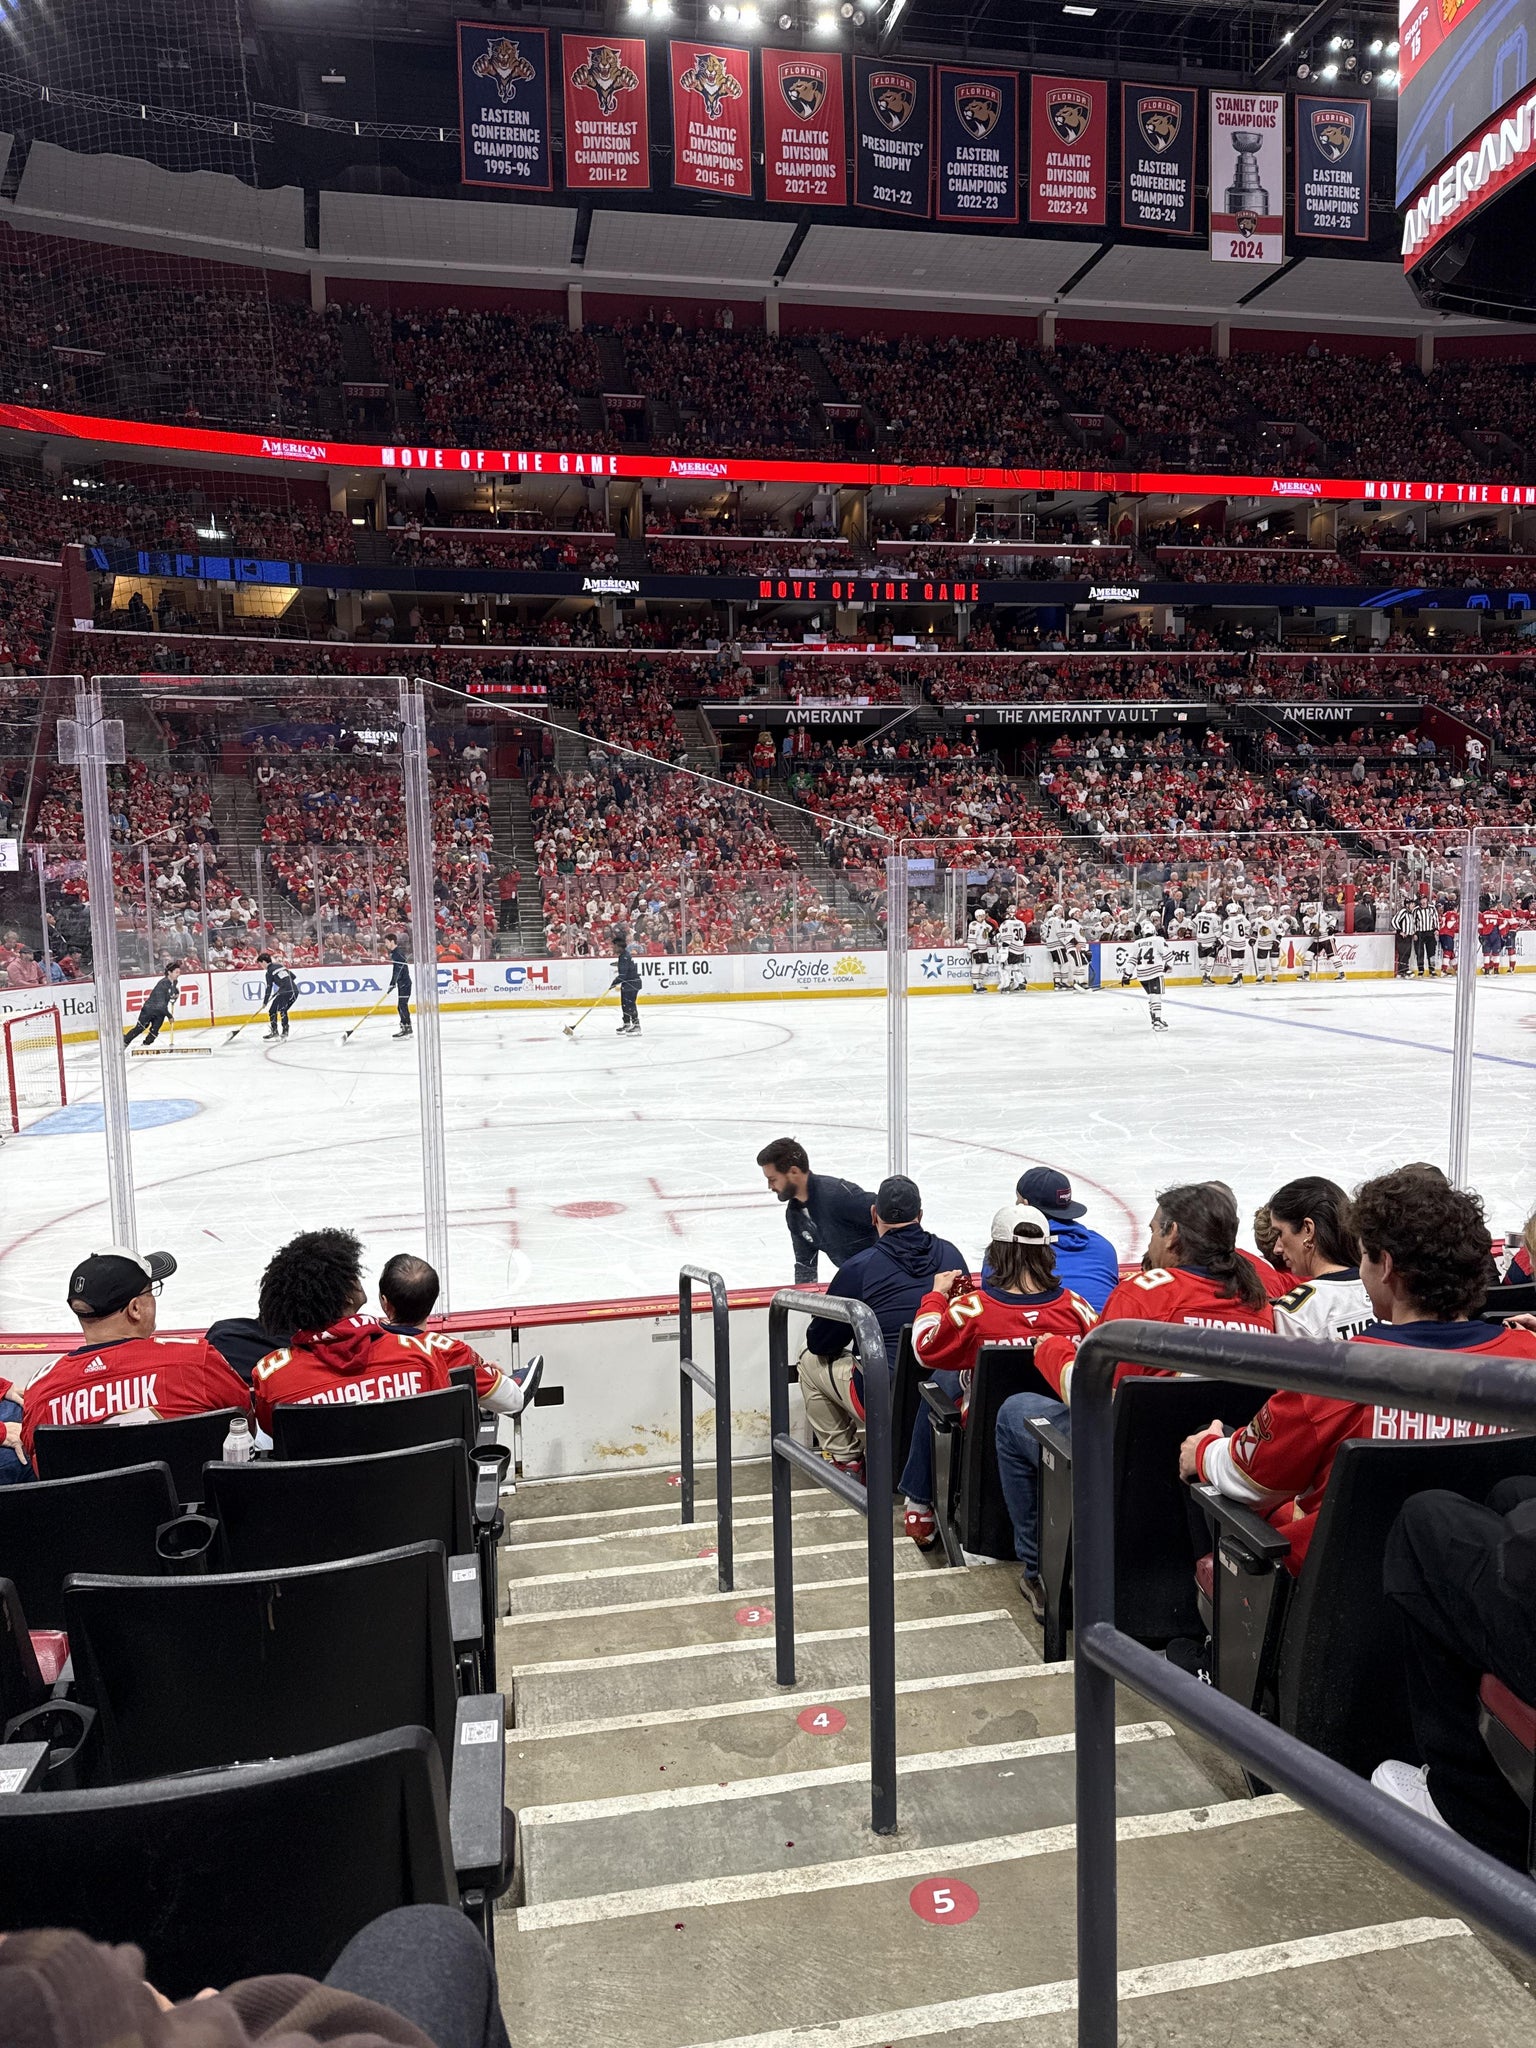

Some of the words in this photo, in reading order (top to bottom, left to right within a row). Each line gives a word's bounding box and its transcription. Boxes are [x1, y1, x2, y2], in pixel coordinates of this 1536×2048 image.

[1404, 6, 1429, 47] SHOTS
[784, 63, 822, 79] FLORIDA
[874, 76, 911, 90] FLORIDA
[960, 86, 996, 98] FLORIDA
[1051, 92, 1087, 105] FLORIDA
[1142, 102, 1177, 114] FLORIDA
[1215, 96, 1257, 113] STANLEY
[1258, 99, 1279, 114] CUP
[480, 107, 531, 126] EASTERN
[1217, 112, 1277, 129] CHAMPIONS
[1315, 113, 1350, 125] FLORIDA
[470, 123, 542, 145] CONFERENCE
[574, 119, 638, 136] SOUTHEAST
[688, 121, 737, 142] ATLANTIC
[582, 135, 632, 151] DIVISION
[780, 128, 829, 145] ATLANTIC
[861, 133, 924, 157] PRESIDENTS'
[473, 140, 540, 161] CHAMPIONS
[690, 137, 736, 157] DIVISION
[782, 145, 829, 161] DIVISION
[955, 146, 1001, 163] EASTERN
[573, 150, 641, 166] CHAMPIONS
[681, 149, 744, 172] CHAMPIONS
[872, 153, 912, 172] TROPHY
[1046, 152, 1092, 168] ATLANTIC
[484, 159, 532, 177] 1995-96
[588, 167, 629, 182] 2011-12
[774, 161, 837, 179] CHAMPIONS
[946, 162, 1009, 179] CONFERENCE
[1046, 168, 1091, 184] DIVISION
[1138, 159, 1179, 177] EASTERN
[1312, 168, 1353, 185] EASTERN
[694, 168, 736, 187] 2015-16
[1130, 173, 1187, 193] CONFERENCE
[784, 179, 828, 195] 2021-22
[872, 184, 913, 205] 2021-22
[947, 178, 1008, 195] CHAMPIONS
[1039, 183, 1098, 200] CHAMPIONS
[1304, 182, 1361, 200] CONFERENCE
[957, 194, 1000, 210] 2022-23
[1047, 199, 1089, 215] 2023-24
[1131, 189, 1185, 208] CHAMPIONS
[1305, 198, 1359, 215] CHAMPIONS
[1138, 205, 1177, 223] 2023-24
[1313, 213, 1352, 229] 2024-25
[1229, 240, 1265, 259] 2024
[347, 387, 363, 397] 332
[606, 398, 623, 408] 333
[1087, 418, 1102, 427] 302
[261, 439, 327, 459] AMERICAN
[381, 447, 443, 468] MOVE
[460, 451, 485, 470] OF
[502, 452, 543, 472] THE
[559, 454, 618, 475] GAME
[668, 459, 728, 475] AMERICAN
[1270, 480, 1322, 495] AMERICAN
[1364, 482, 1412, 499] MOVE
[1425, 485, 1444, 500] OF
[1458, 485, 1488, 502] THE
[581, 577, 641, 593] AMERICAN
[759, 580, 817, 599] MOVE
[832, 581, 856, 600] OF
[871, 582, 909, 600] THE
[923, 583, 979, 601] GAME
[1088, 586, 1140, 600] AMERICAN
[785, 710, 864, 723] AMERANT
[997, 710, 1023, 723] THE
[1027, 710, 1102, 723] AMERANT
[1106, 709, 1158, 722] VAULT
[1283, 708, 1354, 720] AMERANT
[340, 729, 398, 743] ERICAN
[1198, 920, 1210, 935] 16
[1237, 923, 1245, 937] 8
[668, 960, 689, 976] FIT.
[692, 960, 712, 975] GO.
[762, 958, 830, 981] Surfside
[273, 976, 384, 998] ONDA
[494, 984, 522, 993] Cooper
[535, 982, 568, 992] Hunter
[796, 976, 812, 985] ICED
[813, 976, 827, 984] TEA
[832, 975, 855, 983] VODKA
[460, 986, 488, 995] Hunter
[61, 996, 98, 1017] Heal
[84, 1364, 107, 1374] adidas
[48, 1373, 160, 1427] TKACHUK
[1372, 1404, 1516, 1441] BARK
[747, 1610, 761, 1623] 3
[812, 1712, 831, 1728] 4
[932, 1888, 956, 1914] 5
